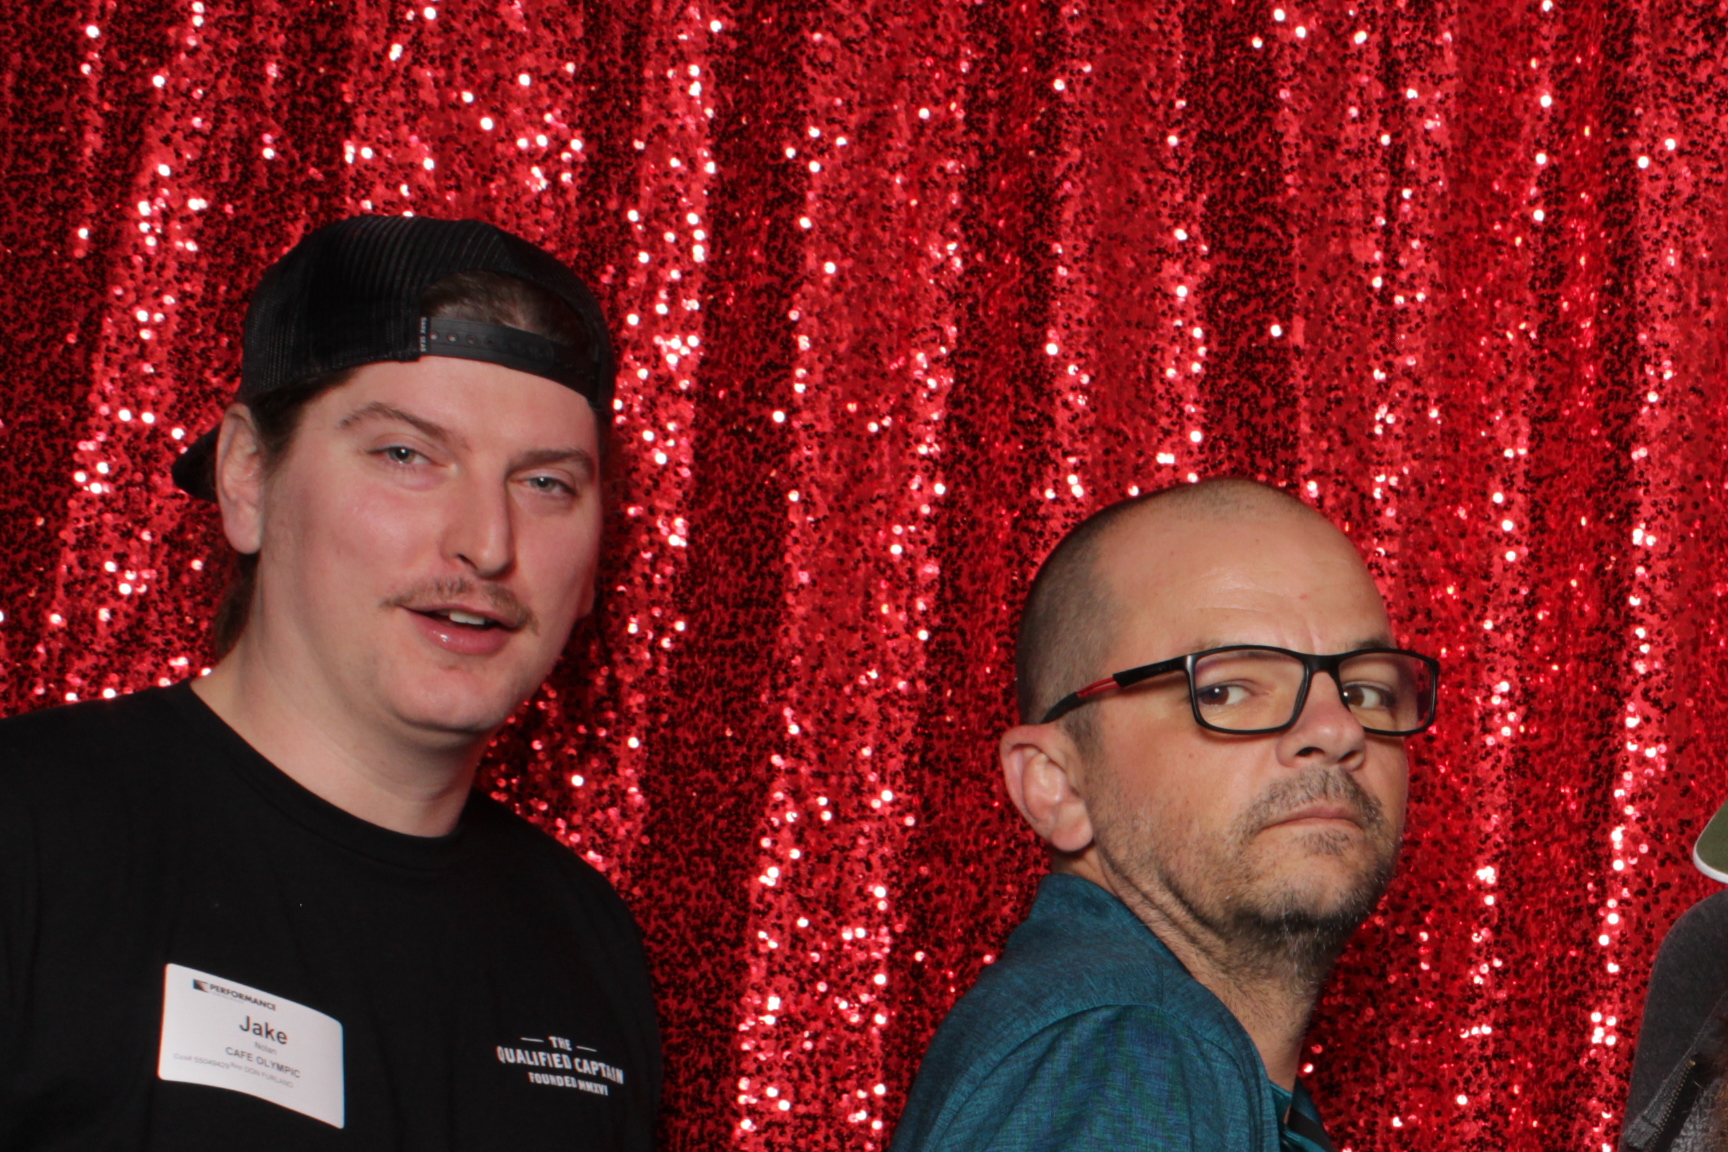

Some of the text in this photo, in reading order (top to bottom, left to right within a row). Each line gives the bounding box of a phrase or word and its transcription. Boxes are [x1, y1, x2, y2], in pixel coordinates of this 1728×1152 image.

[209, 983, 277, 1012] PERFORMANCE
[239, 1015, 288, 1045] Jake
[547, 1035, 573, 1051] THE
[225, 1046, 301, 1079] CAFE OLYMPIC
[496, 1046, 624, 1085] QUALIFIED CAPTAIN
[527, 1071, 577, 1088] FOUNDED
